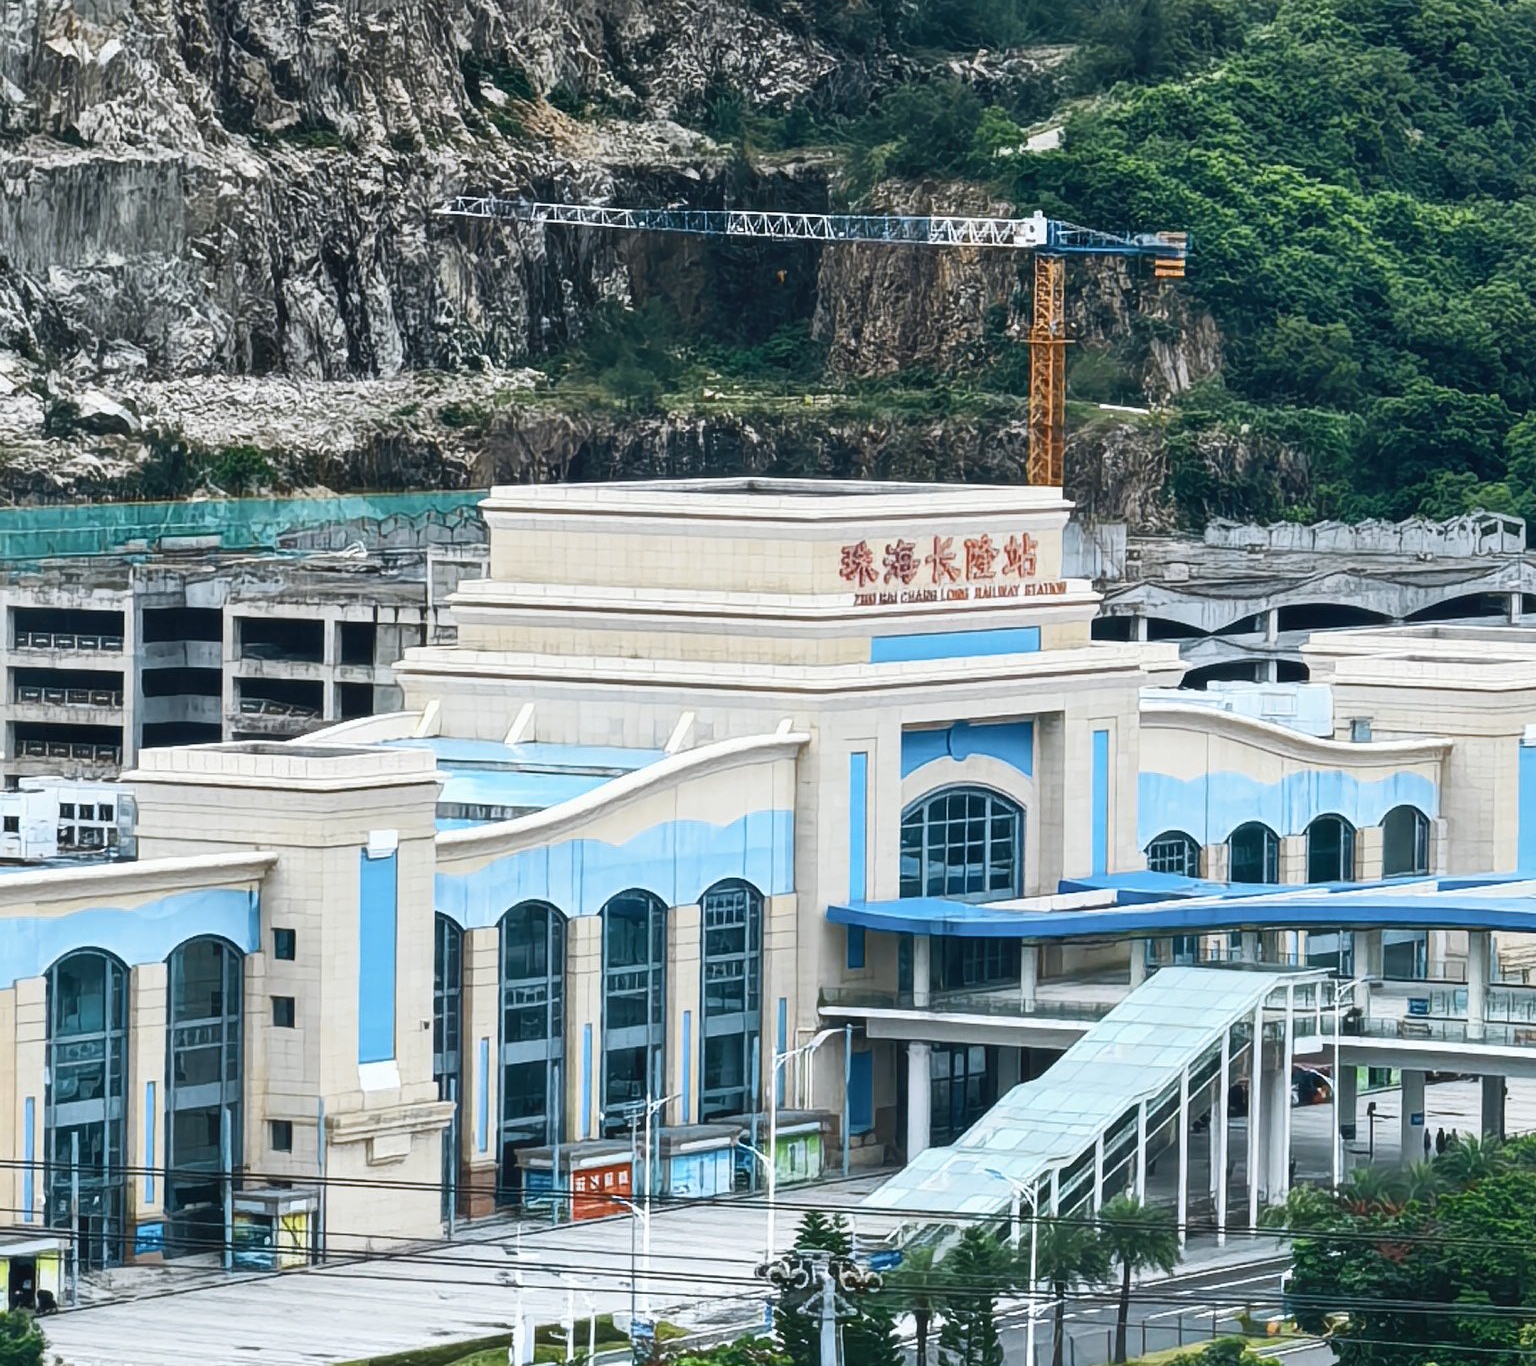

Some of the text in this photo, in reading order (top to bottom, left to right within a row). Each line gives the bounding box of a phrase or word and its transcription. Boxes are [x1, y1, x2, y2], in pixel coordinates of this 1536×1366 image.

[839, 532, 1039, 587] 珠海长隆站
